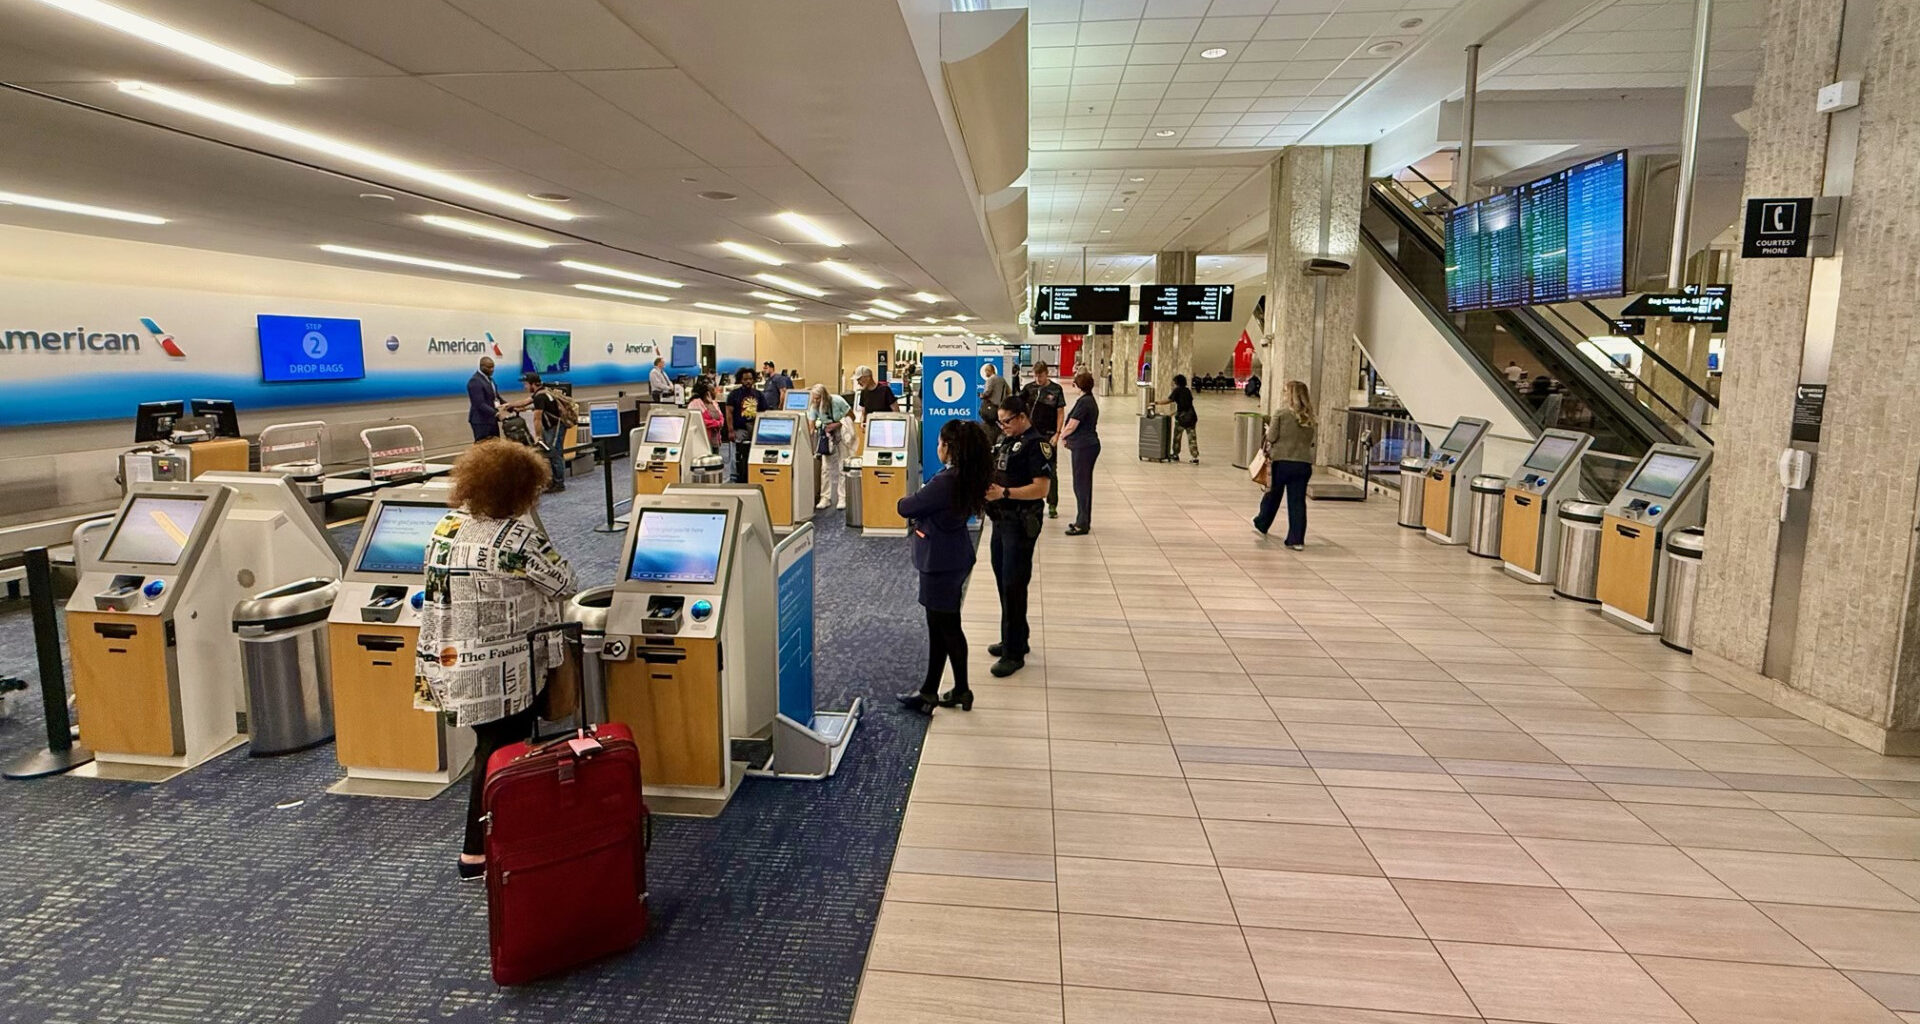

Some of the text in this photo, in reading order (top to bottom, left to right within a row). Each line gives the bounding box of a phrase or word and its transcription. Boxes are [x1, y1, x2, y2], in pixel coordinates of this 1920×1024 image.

[1756, 239, 1796, 247] COURTESY
[309, 337, 321, 354] 2
[428, 337, 486, 352] American
[625, 343, 653, 353] American
[289, 364, 344, 373] DROP BAGS
[944, 376, 952, 397] 1
[929, 408, 971, 416] TAG BAGS
[460, 643, 530, 663] The Fashio
